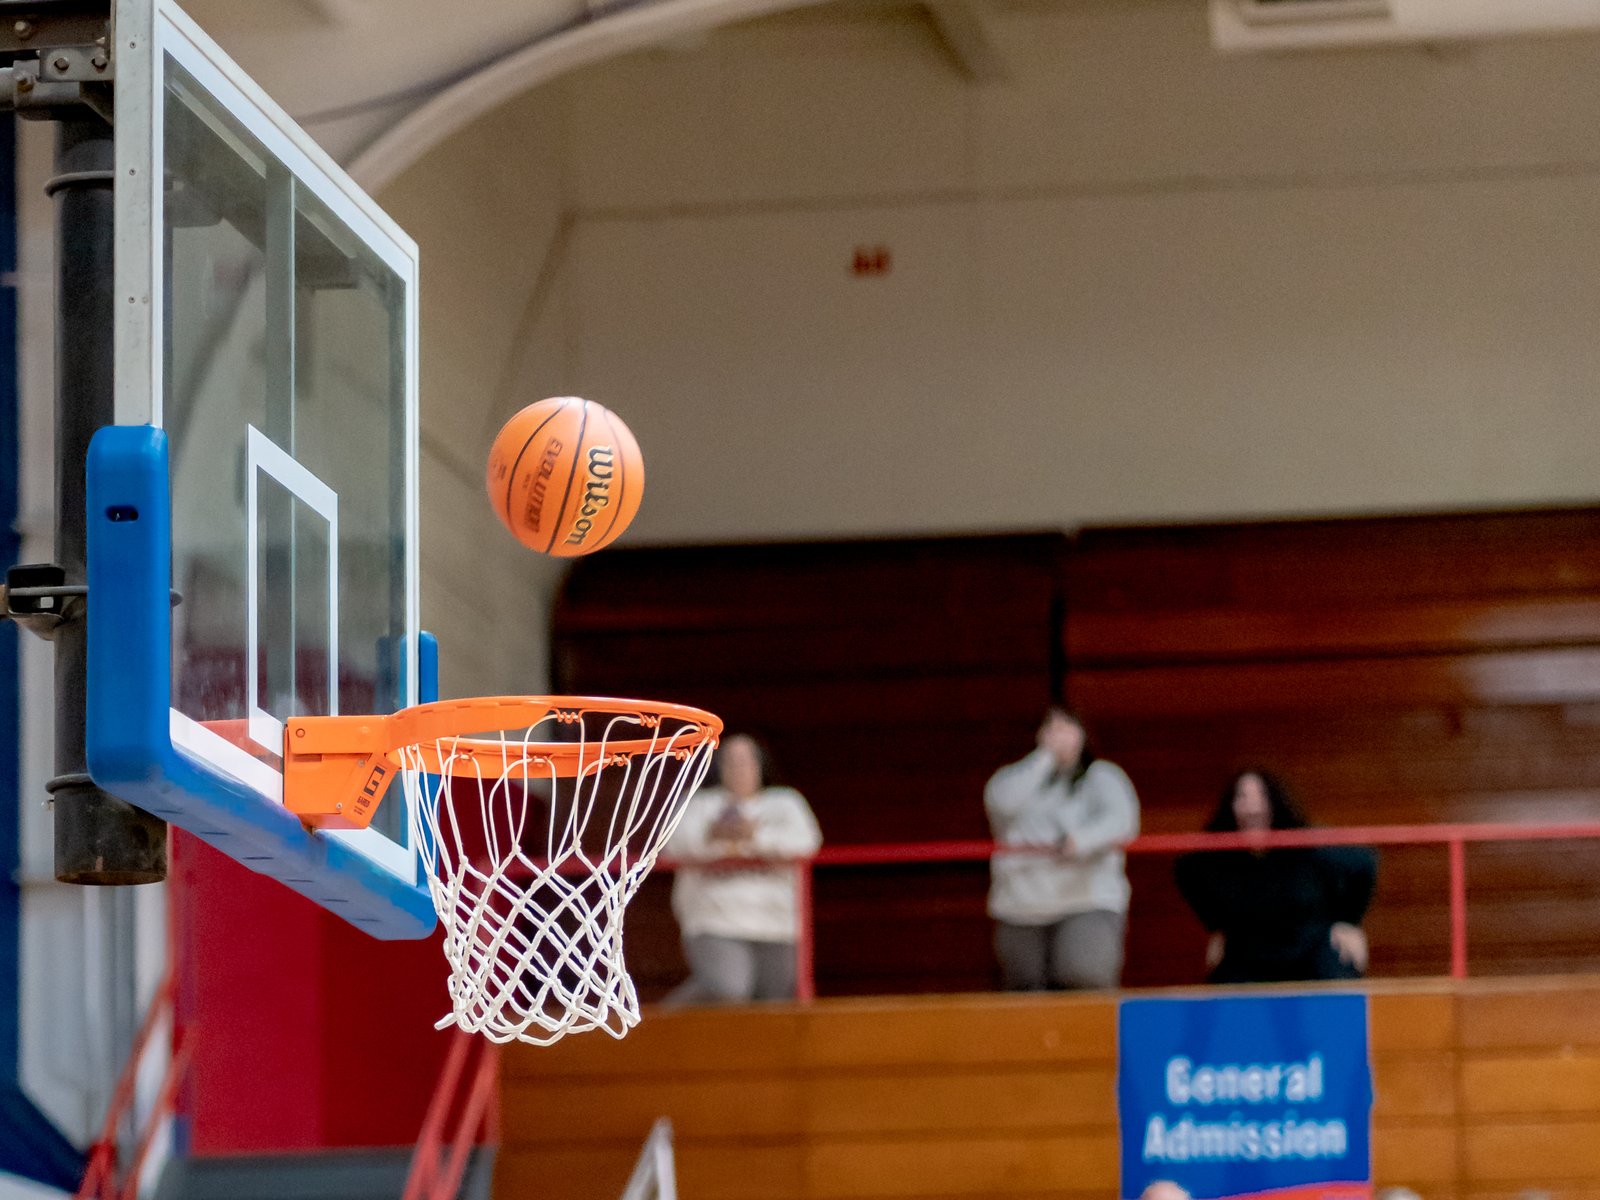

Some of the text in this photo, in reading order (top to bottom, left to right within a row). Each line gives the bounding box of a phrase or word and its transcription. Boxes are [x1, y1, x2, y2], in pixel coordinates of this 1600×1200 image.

[563, 445, 613, 545] Wilson
[1166, 1056, 1323, 1103] General
[1144, 1114, 1346, 1161] Admission
